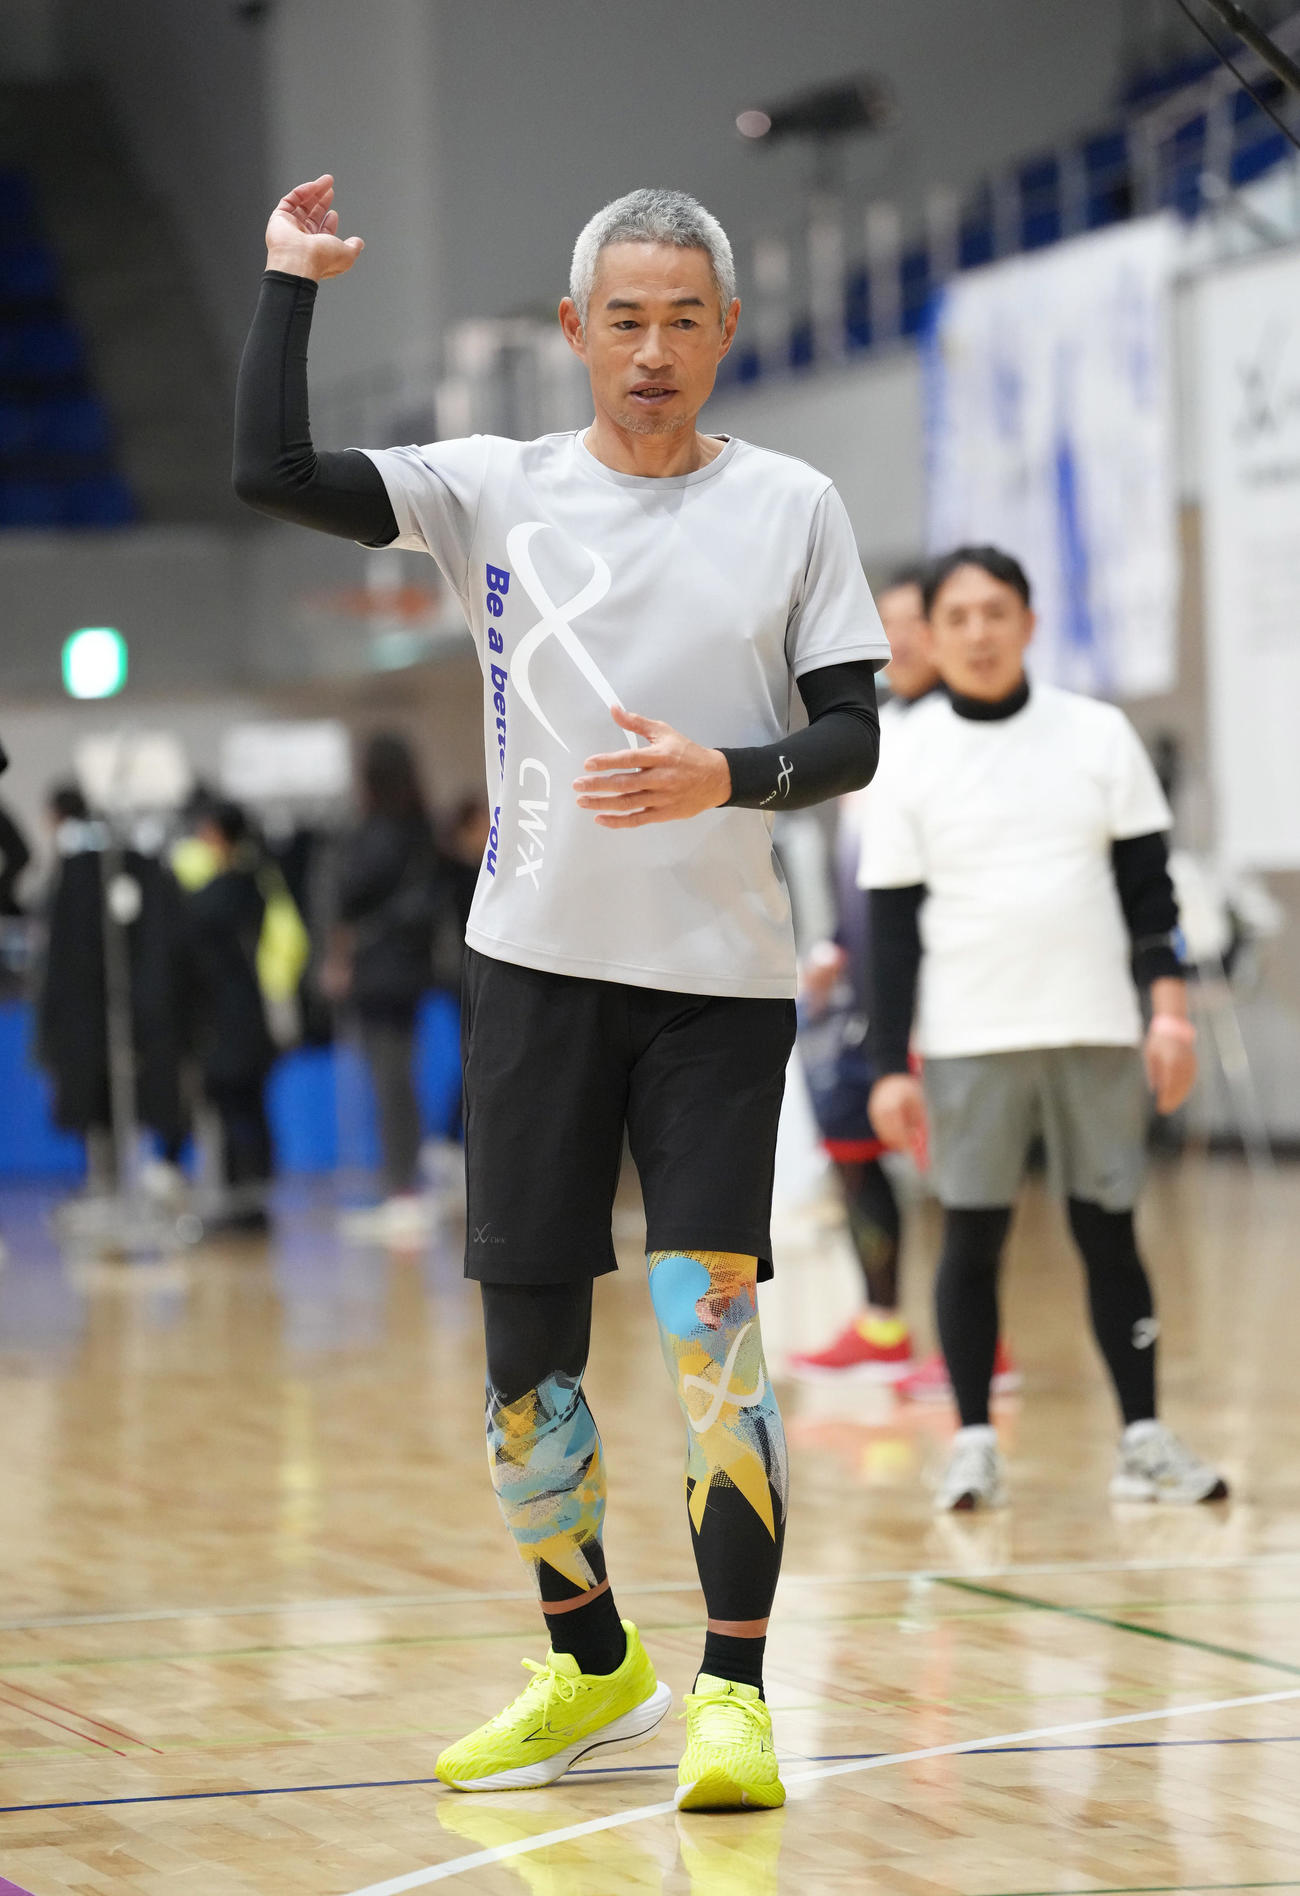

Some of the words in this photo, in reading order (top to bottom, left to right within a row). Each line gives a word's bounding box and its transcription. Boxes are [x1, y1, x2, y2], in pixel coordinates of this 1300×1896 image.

[486, 563, 510, 617] Be
[488, 627, 503, 654] a
[491, 663, 507, 782] bett
[516, 757, 550, 891] CW-X
